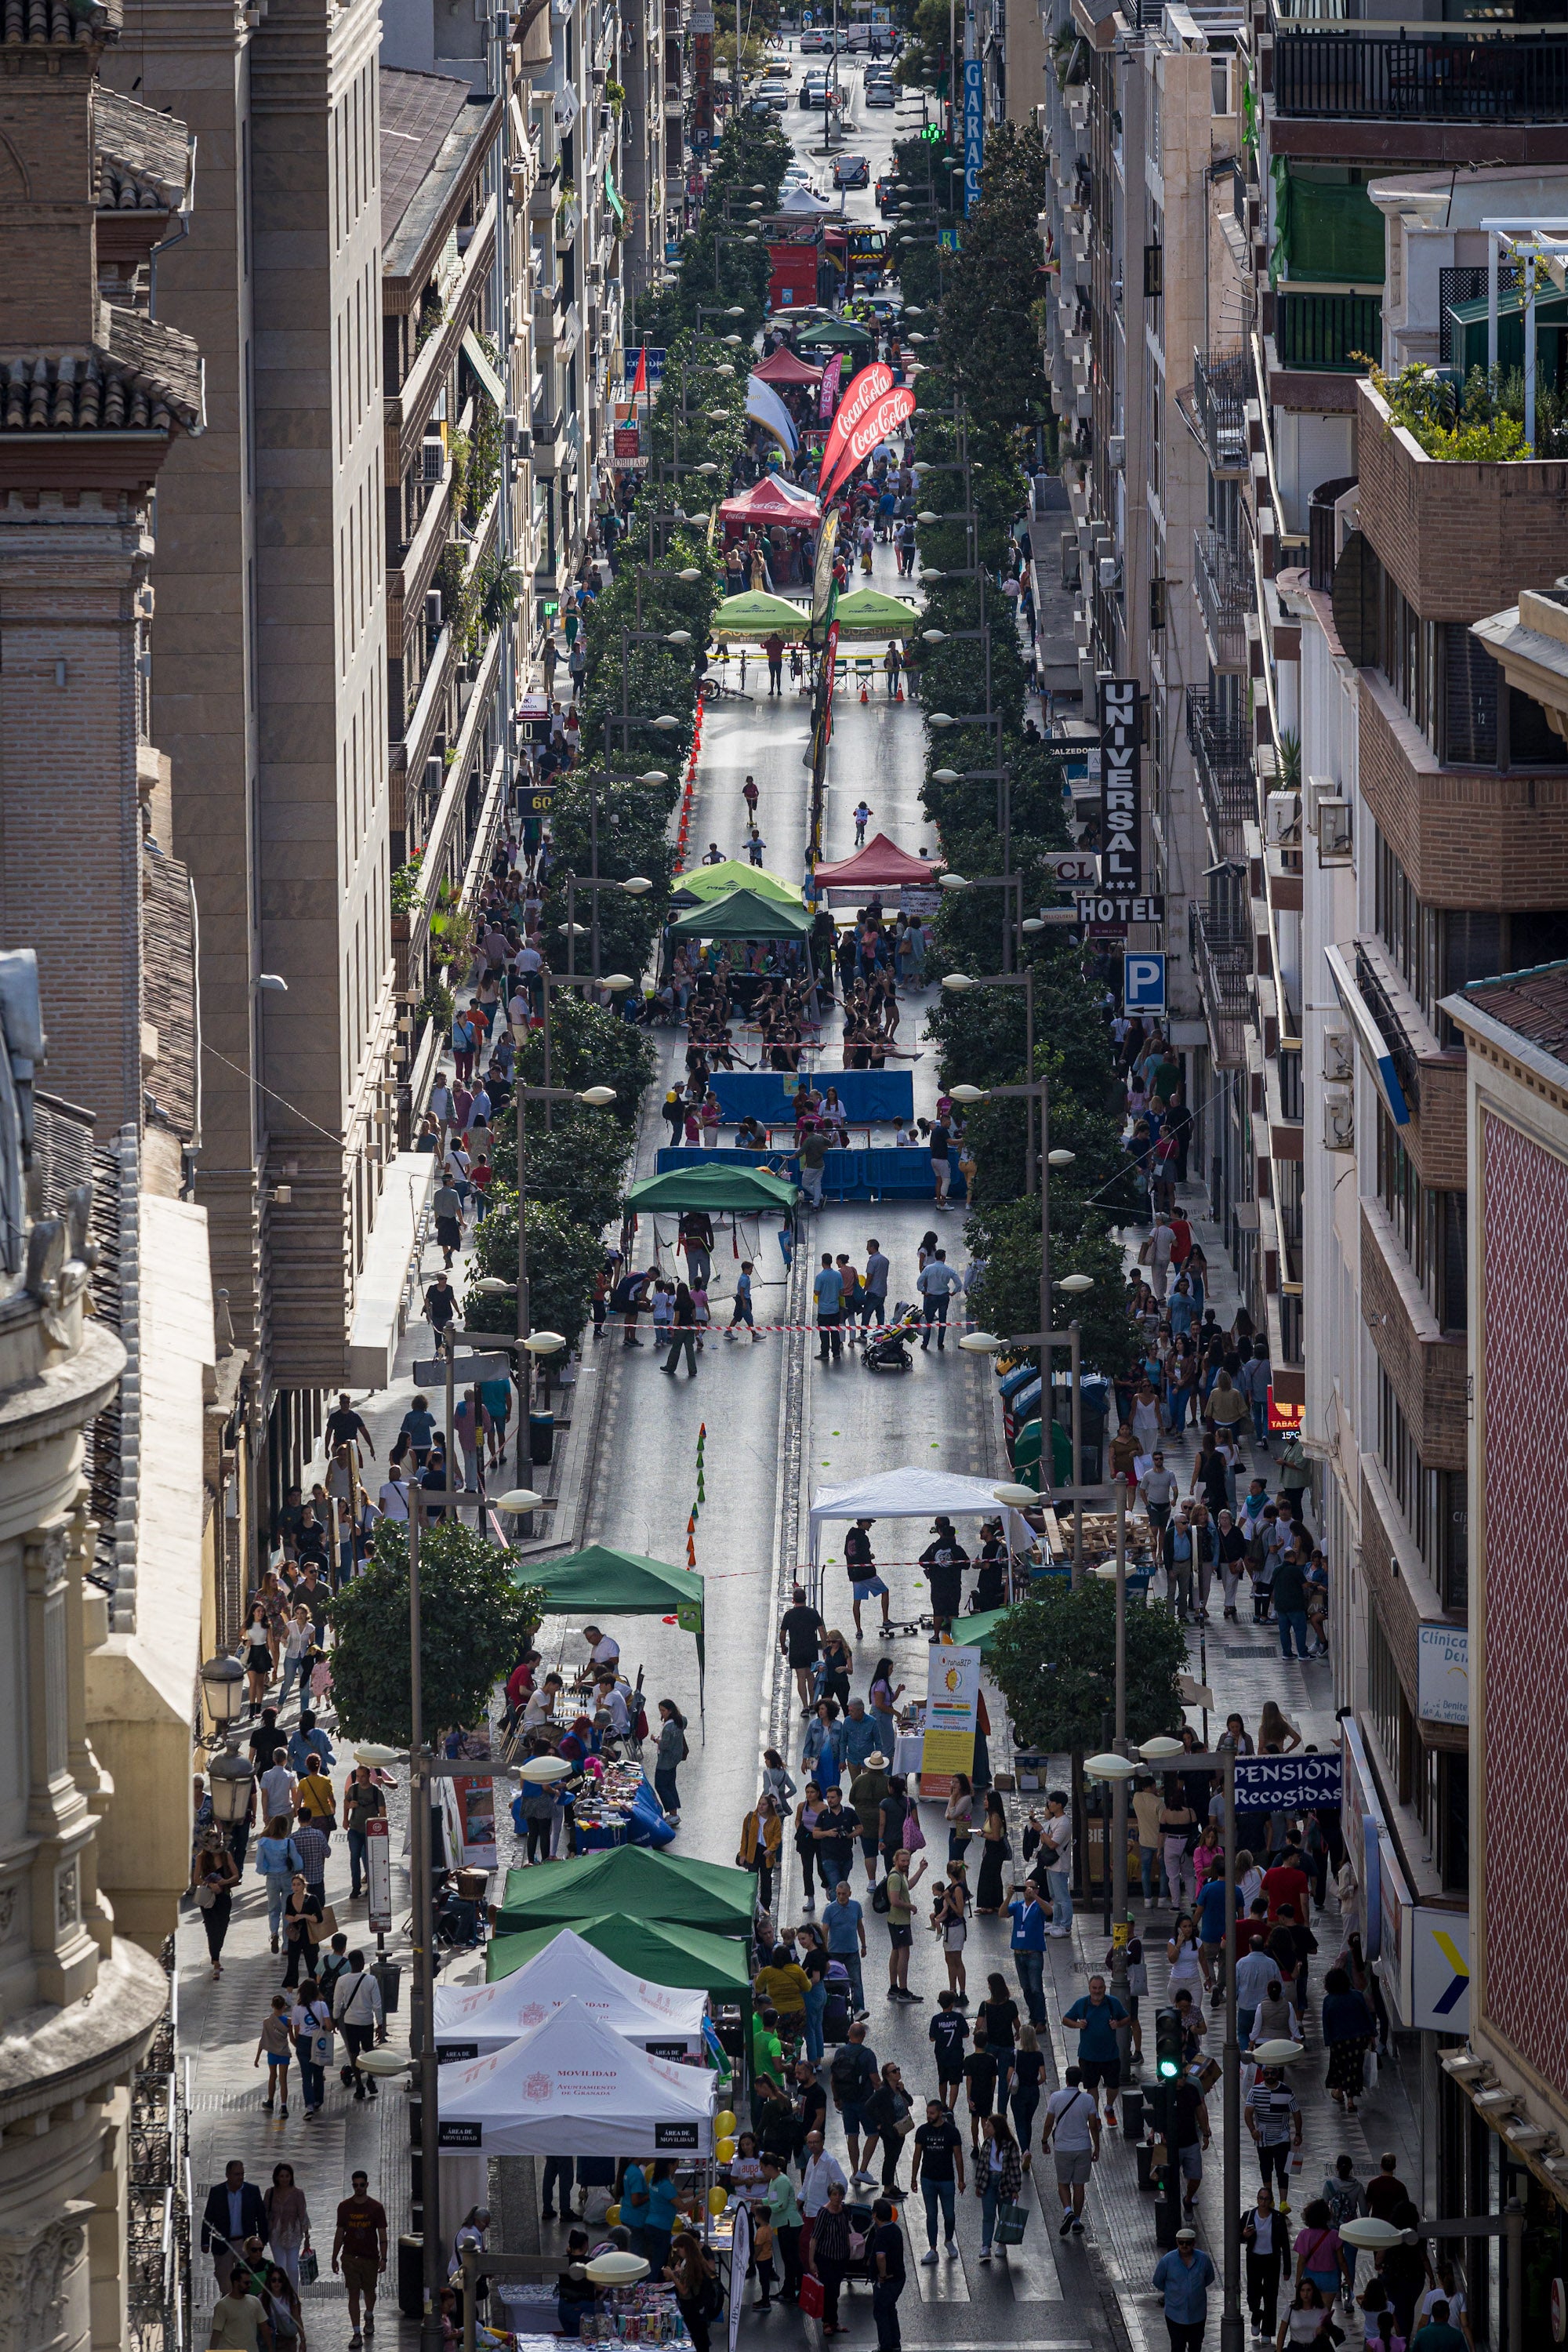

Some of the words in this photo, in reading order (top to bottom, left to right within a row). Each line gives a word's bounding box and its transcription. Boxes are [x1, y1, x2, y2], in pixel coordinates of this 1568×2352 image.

[697, 131, 709, 143] P
[822, 373, 833, 403] EYSA
[837, 365, 889, 440] Coca-Cola
[851, 390, 910, 459] Coca-Cola
[601, 458, 647, 467] INMOBILIARI
[745, 501, 786, 510] Coca-Cola
[725, 512, 747, 521] Coca-Cola
[791, 517, 812, 526] Coca-Cola
[1050, 746, 1101, 756] CALZEDO
[1105, 684, 1136, 873] UNIVERSAL
[1080, 898, 1161, 922] HOTEL
[1130, 960, 1160, 999] P
[1421, 1631, 1468, 1649] Clínica
[1443, 1700, 1468, 1711] Benite
[1235, 1759, 1341, 1783] PENSIÓN
[1235, 1785, 1341, 1807] Recogidas
[944, 2029, 955, 2048] 7
[742, 2164, 759, 2176] aupa
